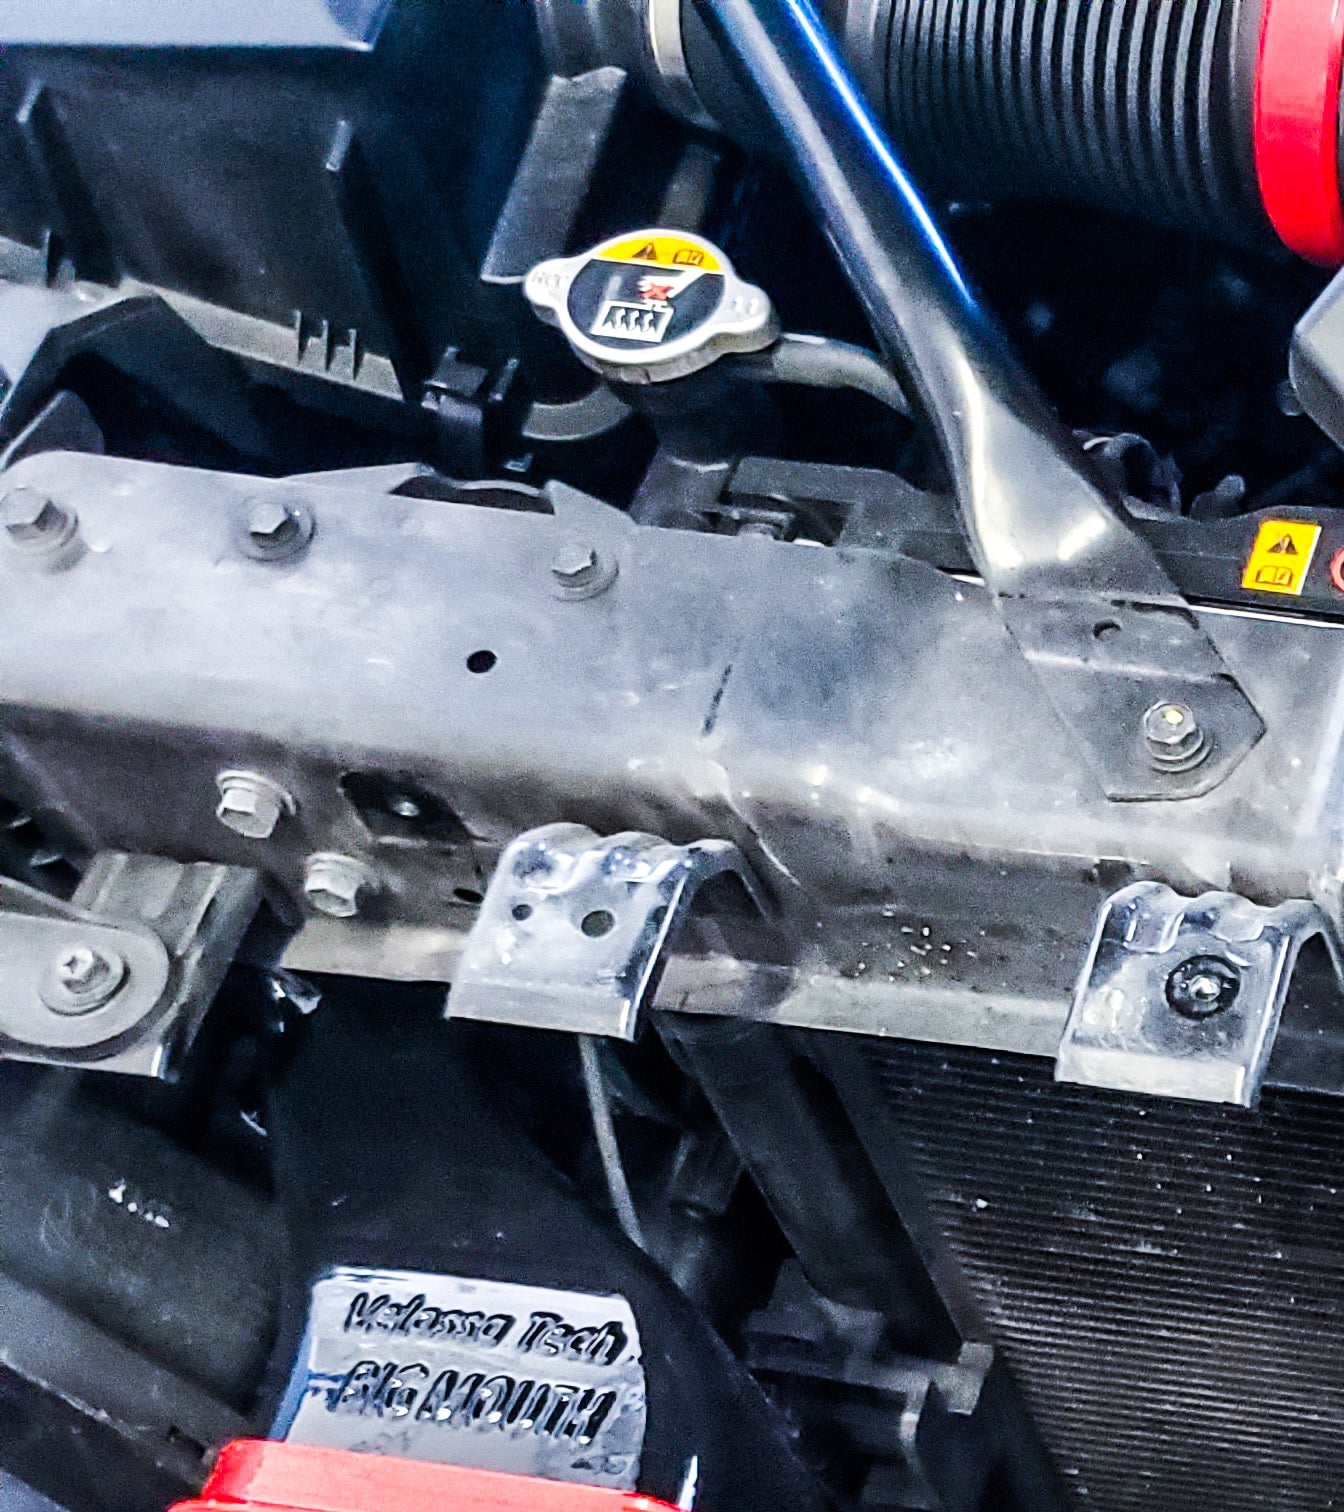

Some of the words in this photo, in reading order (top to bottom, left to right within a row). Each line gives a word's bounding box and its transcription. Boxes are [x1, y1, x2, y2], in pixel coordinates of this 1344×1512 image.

[518, 1310, 629, 1366] Tech
[326, 1359, 429, 1419] BIG
[417, 1369, 618, 1446] MOUTH
